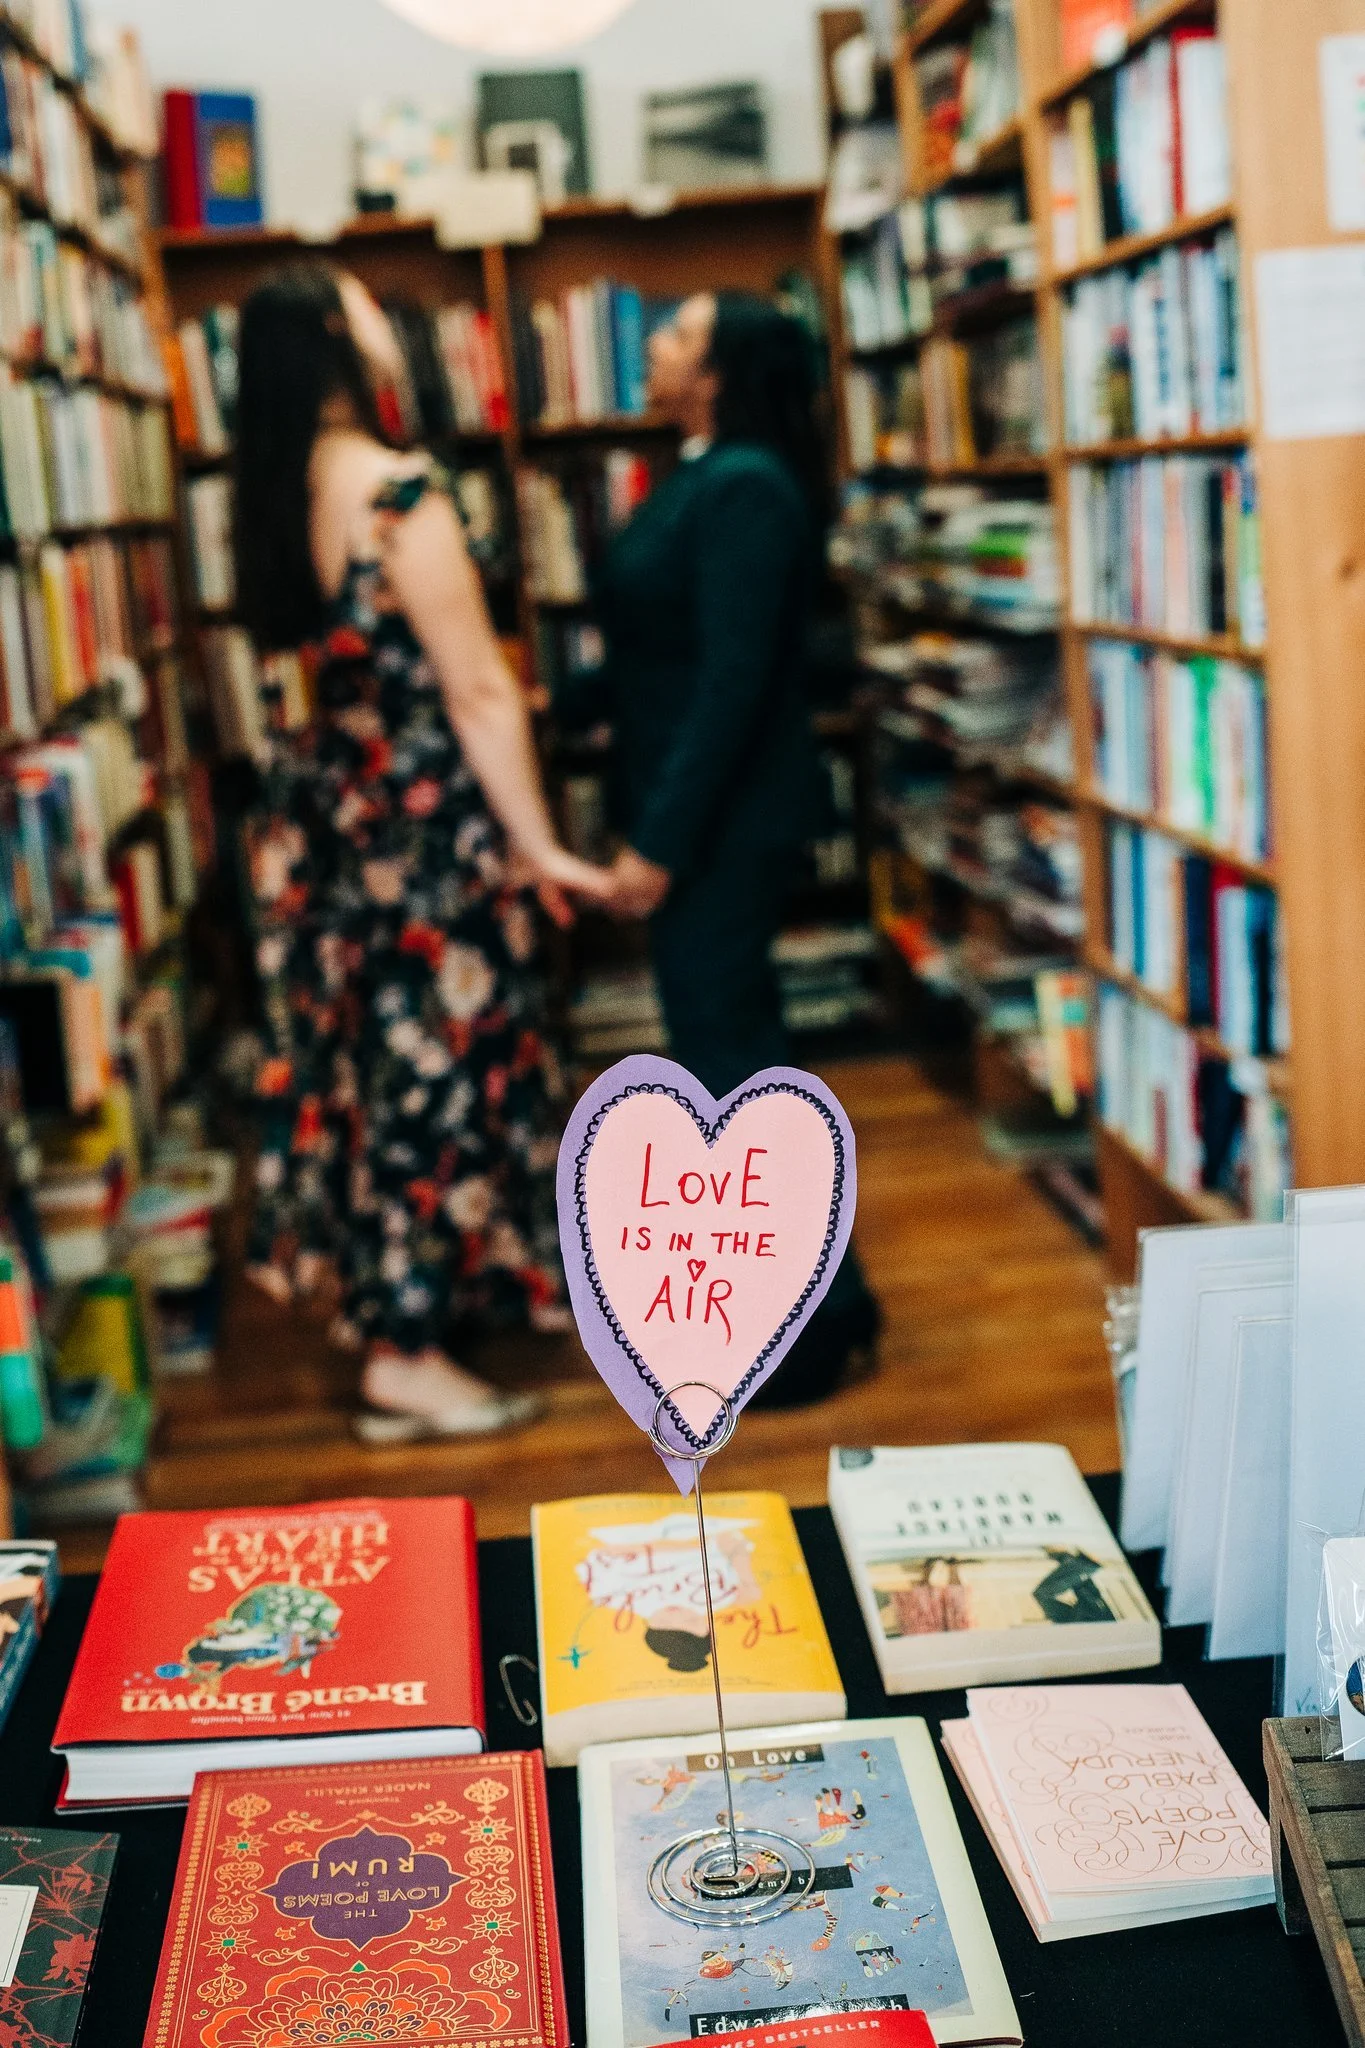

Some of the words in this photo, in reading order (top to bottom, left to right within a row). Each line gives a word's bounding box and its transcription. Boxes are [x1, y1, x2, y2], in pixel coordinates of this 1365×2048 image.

[641, 1143, 769, 1208] LOVE
[621, 1226, 652, 1251] IS
[668, 1232, 694, 1252] IN
[711, 1231, 777, 1257] THE
[193, 1524, 389, 1556] HEART
[187, 1557, 390, 1593] ATLAS
[583, 1544, 675, 1595] Test
[592, 1569, 738, 1633] Bride
[714, 1604, 797, 1650] The
[120, 1690, 275, 1715] Brown
[285, 1681, 427, 1710] Brené
[752, 1748, 808, 1766] Love
[1063, 1751, 1211, 1777] NERUDA
[305, 1786, 368, 1798] KHALILI
[373, 1782, 431, 1794] NADER
[1104, 1770, 1217, 1790] PABLO
[1113, 1802, 1237, 1825] POEMS
[1152, 1825, 1258, 1848] LOVE
[312, 1856, 415, 1879] RUMI
[283, 1890, 369, 1909] POEMS
[377, 1885, 441, 1902] LOVE
[343, 1908, 378, 1919] THE
[765, 2020, 881, 2044] BESTSELLER
